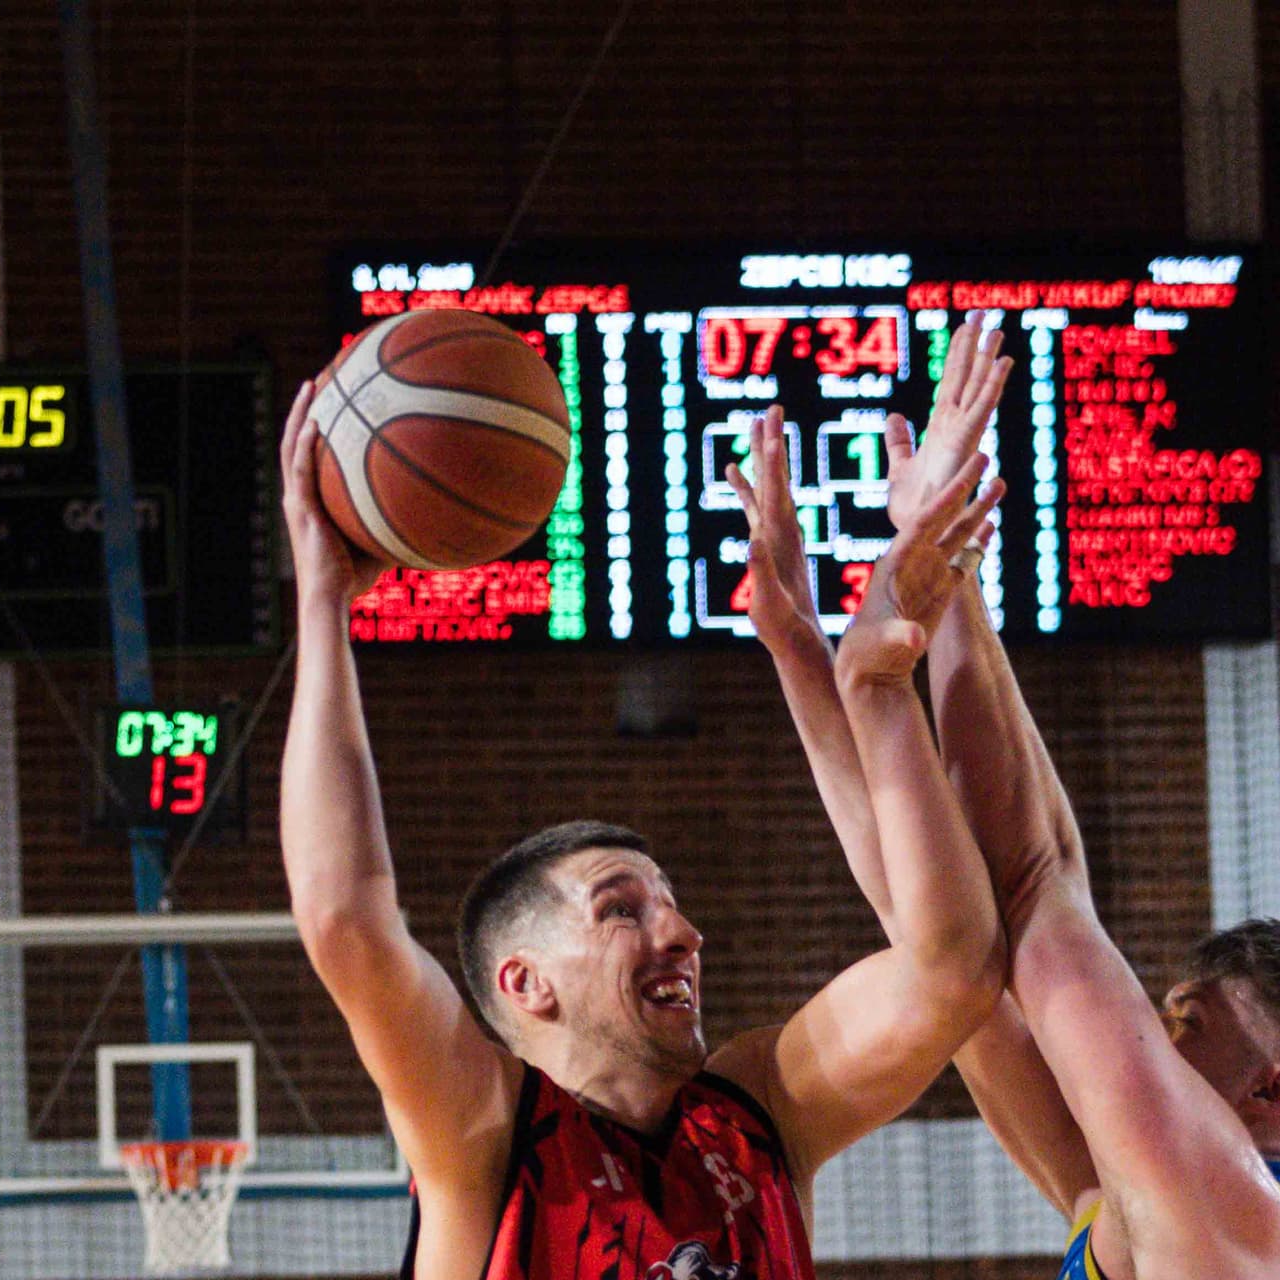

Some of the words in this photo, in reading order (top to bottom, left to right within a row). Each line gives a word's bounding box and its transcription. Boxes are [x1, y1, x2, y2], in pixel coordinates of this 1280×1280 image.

[704, 317, 898, 377] 07:34
[116, 711, 217, 756] 07:34
[148, 753, 208, 814] 13
